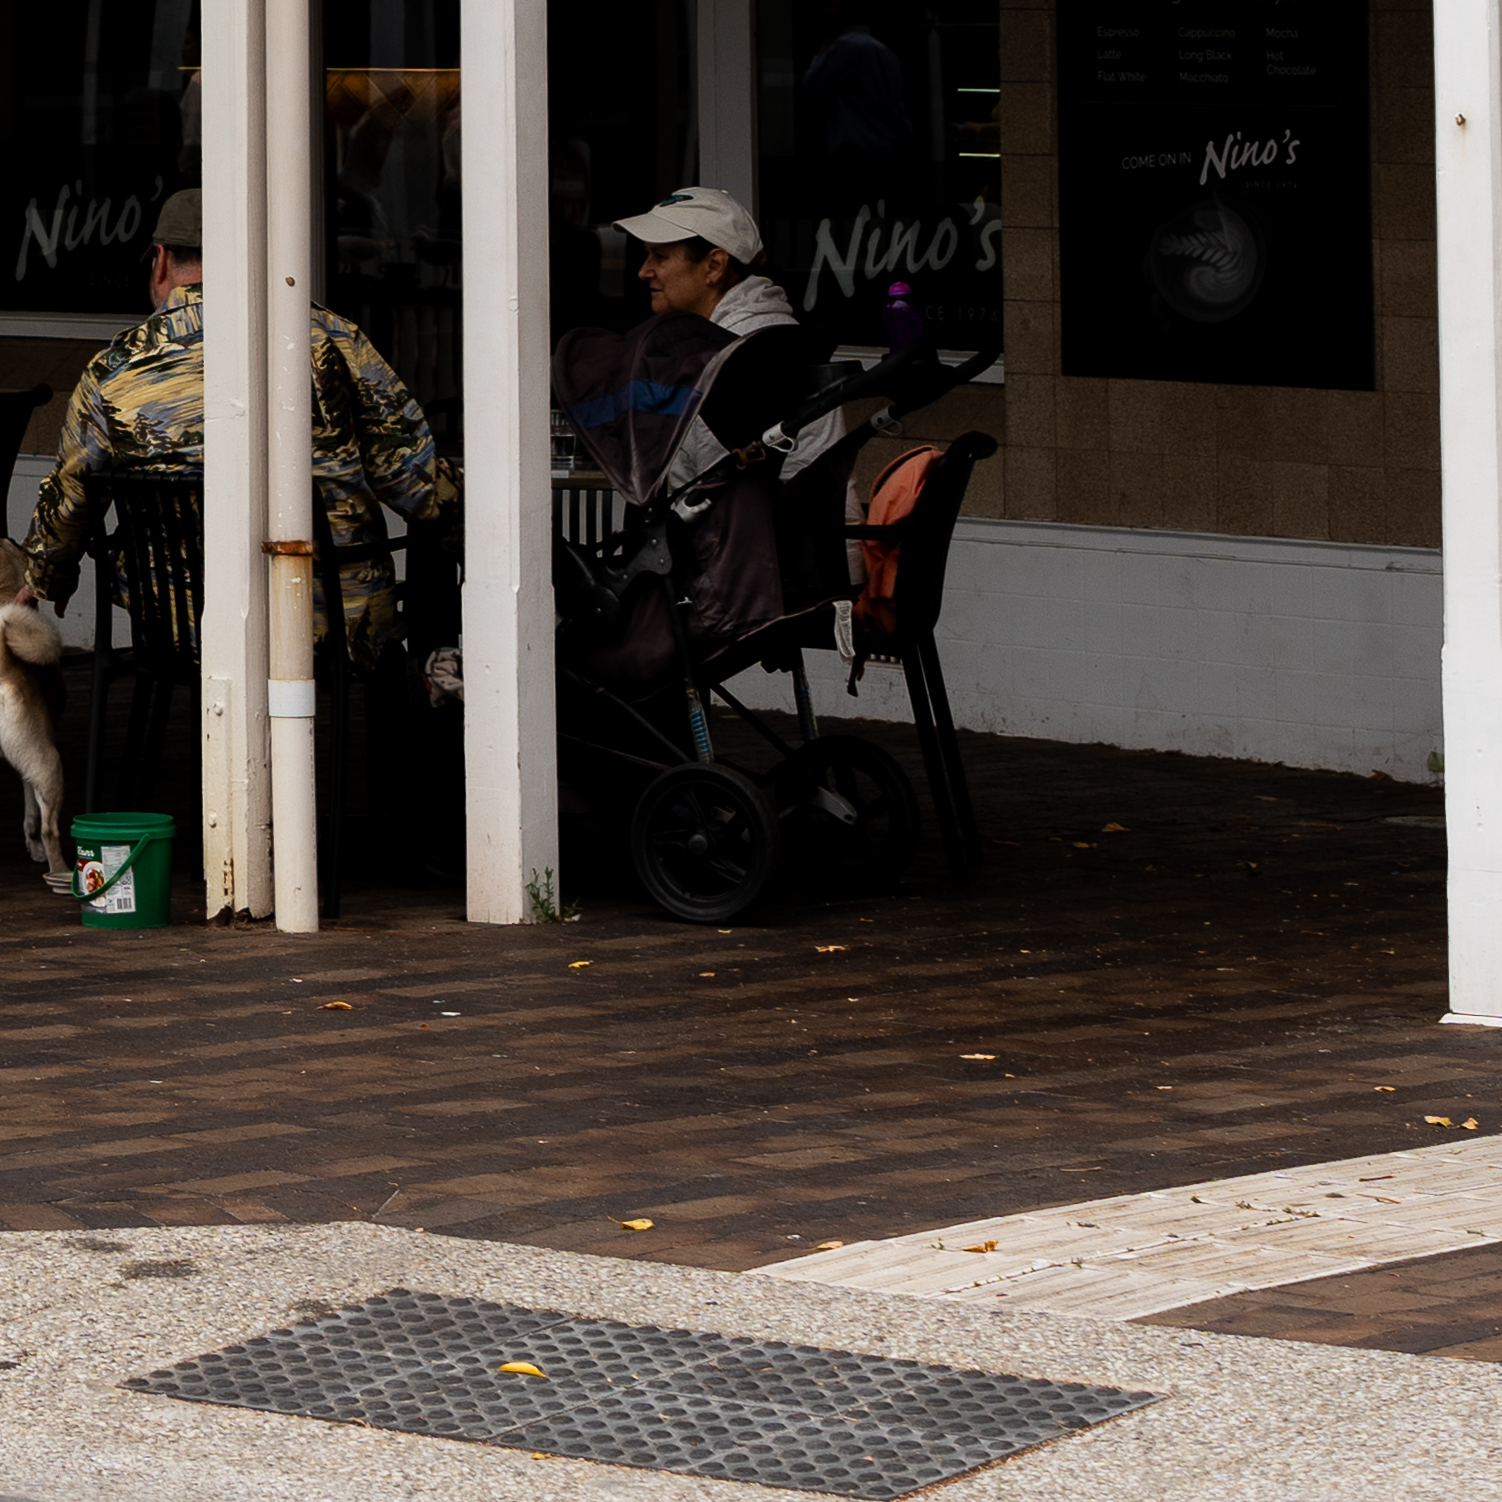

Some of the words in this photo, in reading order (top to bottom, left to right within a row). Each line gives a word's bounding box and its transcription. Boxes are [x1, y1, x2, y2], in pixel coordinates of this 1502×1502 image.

[1096, 26, 1141, 40] Espresso
[1178, 27, 1237, 41] Cappuccino
[1265, 27, 1299, 39] Mocha
[1096, 48, 1123, 60] Latte
[1178, 49, 1204, 63] Long
[1205, 49, 1233, 61] Black
[1266, 50, 1284, 61] Hot
[1096, 70, 1117, 82] Flat
[1117, 71, 1147, 83] White
[1266, 64, 1317, 76] Chocolate
[1178, 71, 1230, 84] Macchiato
[1121, 154, 1156, 171] COME
[1158, 153, 1177, 167] ON
[1179, 152, 1192, 165] IN
[1198, 127, 1302, 186] Nino's
[14, 174, 165, 282] Nino'
[803, 196, 1003, 312] Nino's
